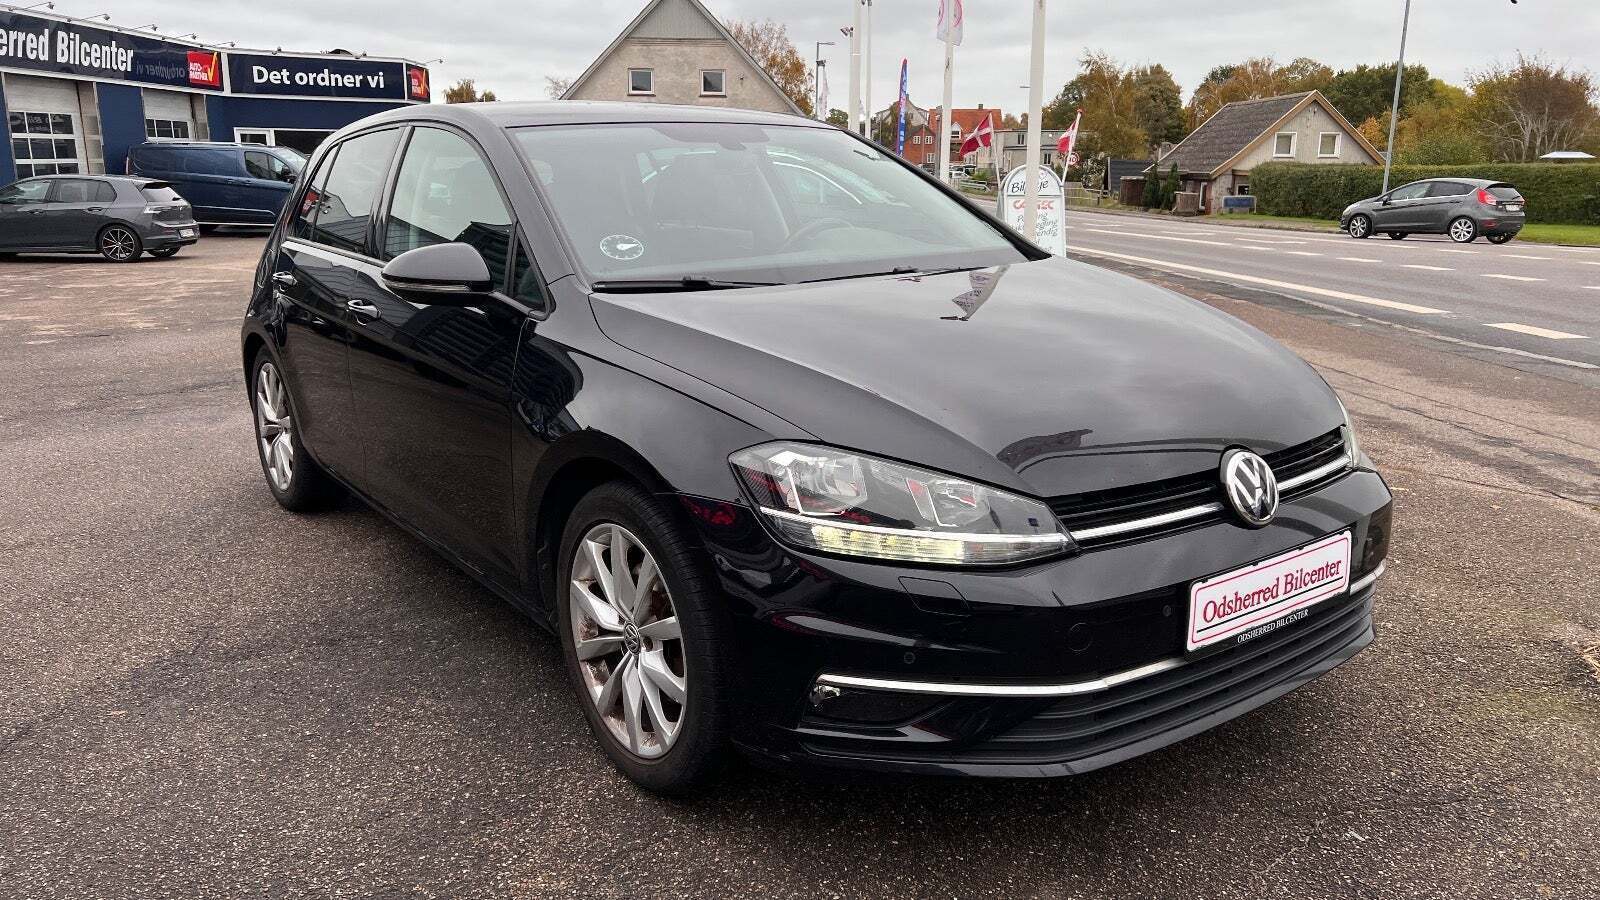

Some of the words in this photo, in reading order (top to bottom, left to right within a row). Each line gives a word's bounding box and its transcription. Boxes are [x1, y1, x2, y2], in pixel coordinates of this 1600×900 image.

[56, 30, 134, 72] Bilcenter
[252, 65, 291, 84] Det
[294, 69, 363, 88] ordner
[367, 72, 385, 89] vi
[1203, 577, 1280, 623] Odsherred
[1283, 560, 1342, 595] Bilcenter
[1237, 623, 1276, 643] ODSHERRED
[1276, 609, 1309, 629] BILCENTER
